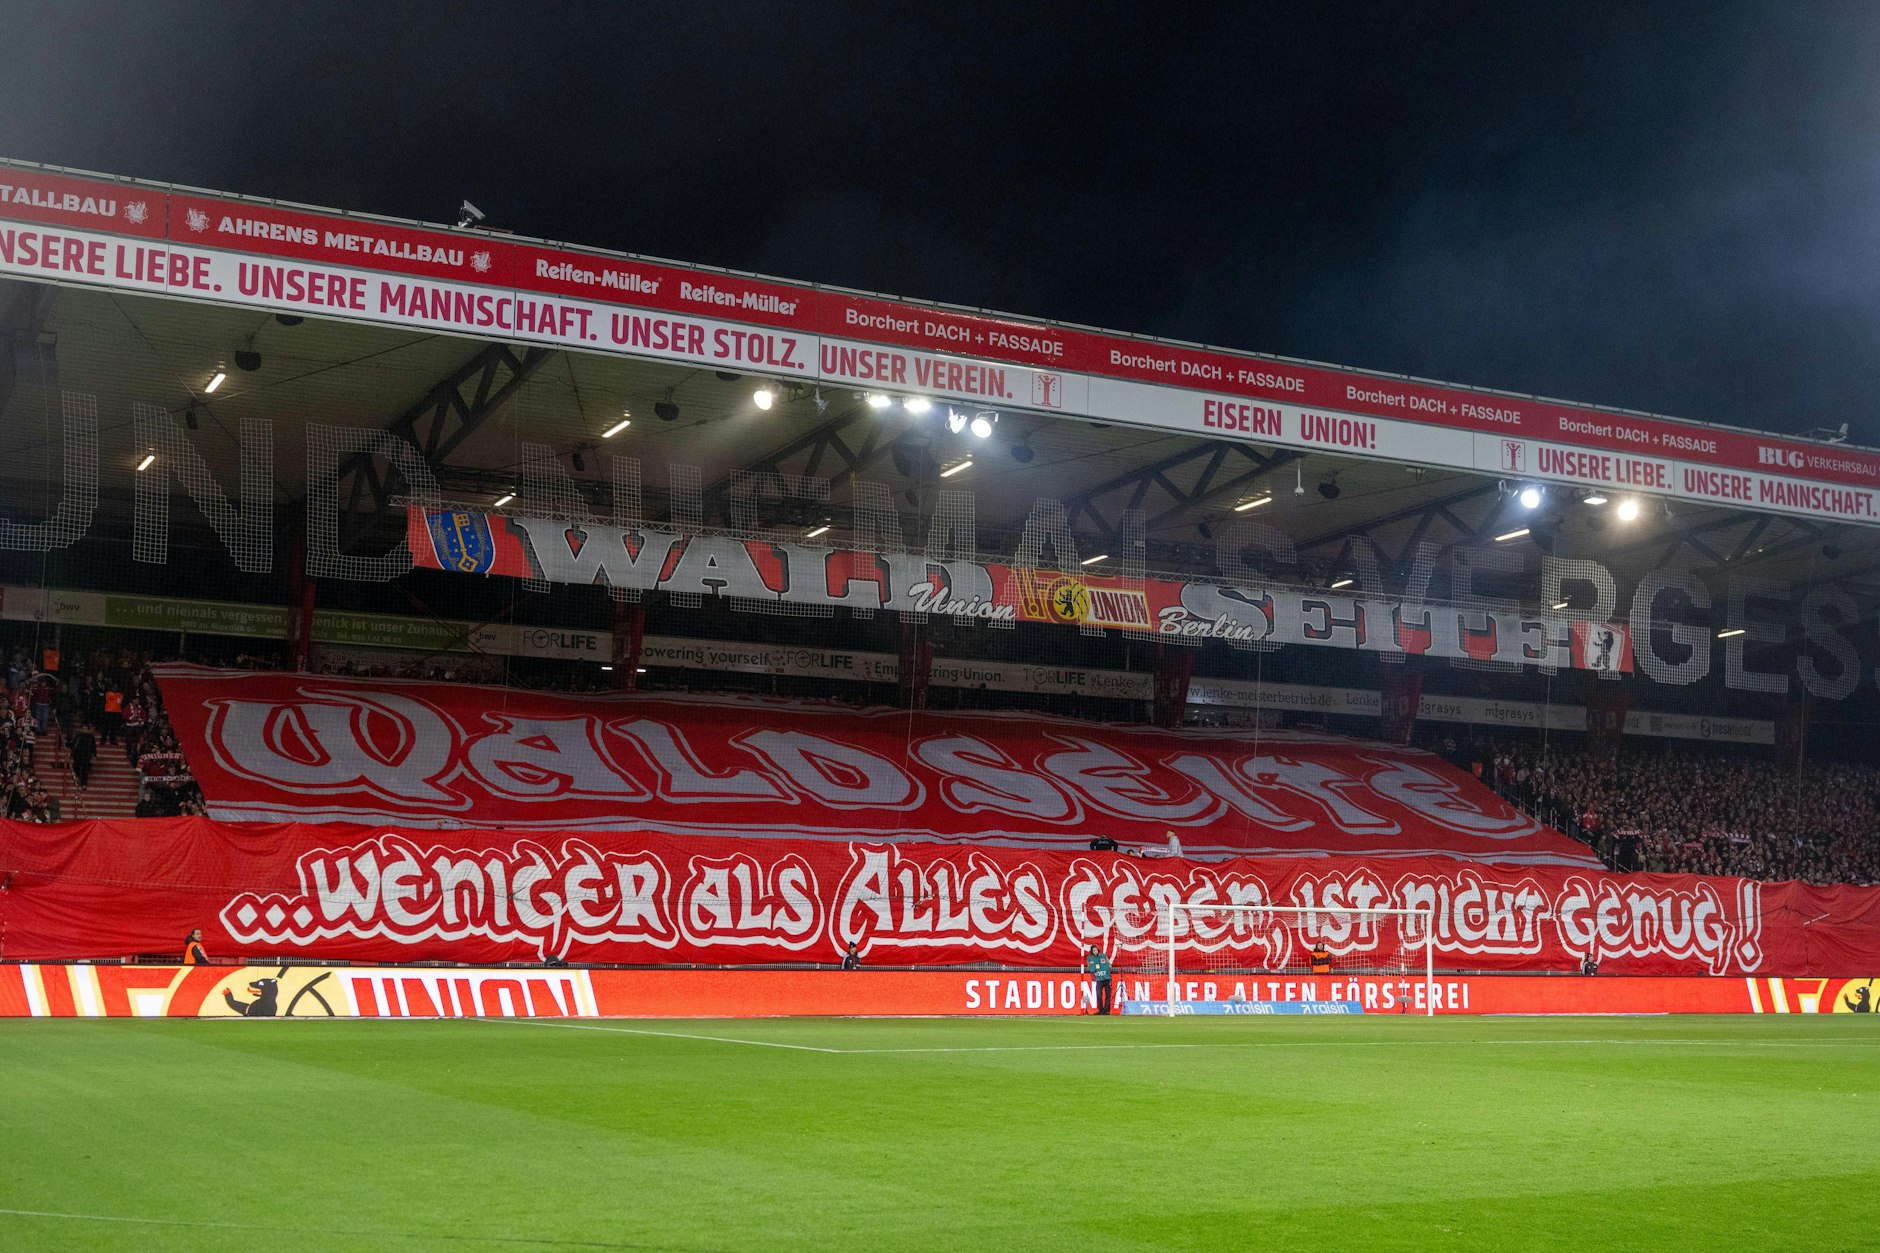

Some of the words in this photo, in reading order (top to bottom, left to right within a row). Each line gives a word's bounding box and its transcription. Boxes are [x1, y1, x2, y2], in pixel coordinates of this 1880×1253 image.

[217, 215, 318, 246] AHRENS
[324, 232, 465, 267] METALLBAU
[116, 243, 223, 292] LIEBE.
[238, 261, 367, 311] UNSERE
[380, 281, 598, 341] MANNSCHAFT.
[611, 312, 706, 357] UNSER
[713, 327, 805, 370] STOLZ.
[821, 343, 907, 384] UNSER
[914, 356, 1014, 400] VEREIN.
[845, 308, 919, 335] Borchert
[924, 321, 970, 342] DACH
[975, 333, 985, 345] +
[989, 331, 1064, 357] FASSADE
[1110, 349, 1176, 374] Borchert
[1181, 361, 1222, 381] DACH
[1226, 371, 1235, 382] +
[1238, 369, 1305, 393] FASSADE
[1203, 398, 1282, 437] EISERN
[1300, 413, 1377, 450] UNION!
[1346, 385, 1406, 408] Borchert
[1410, 396, 1447, 414] DACH
[1450, 405, 1458, 415] +
[1461, 403, 1521, 425] FASSADE
[1559, 416, 1613, 438] Borchert
[1615, 426, 1650, 444] DACH
[1652, 435, 1660, 445] +
[1662, 433, 1717, 454] FASSADE
[1757, 446, 1805, 469] BUG
[1807, 455, 1877, 477] VERKEHRSBAU
[1538, 447, 1611, 482] UNSERE
[1615, 459, 1673, 490] LIEBE.
[1684, 468, 1752, 500] UNSERE
[1759, 479, 1877, 517] MANNSCHAFT.
[513, 515, 993, 613] WALD
[1179, 581, 1576, 670] SEITE
[908, 580, 1017, 623] Union
[1088, 588, 1150, 626] UNION
[352, 621, 367, 631] ist
[371, 622, 405, 634] unser
[1158, 605, 1256, 641] Berlin
[1346, 692, 1380, 707] Lenke
[965, 979, 1099, 1010] STADION
[1113, 980, 1151, 1009] AN
[1166, 981, 1218, 1002] DER
[1233, 981, 1317, 1002] ALTEN
[1331, 976, 1470, 1010] FÖRSTEREI
[1234, 1002, 1275, 1015] raisin
[1312, 1002, 1350, 1015] raisin
